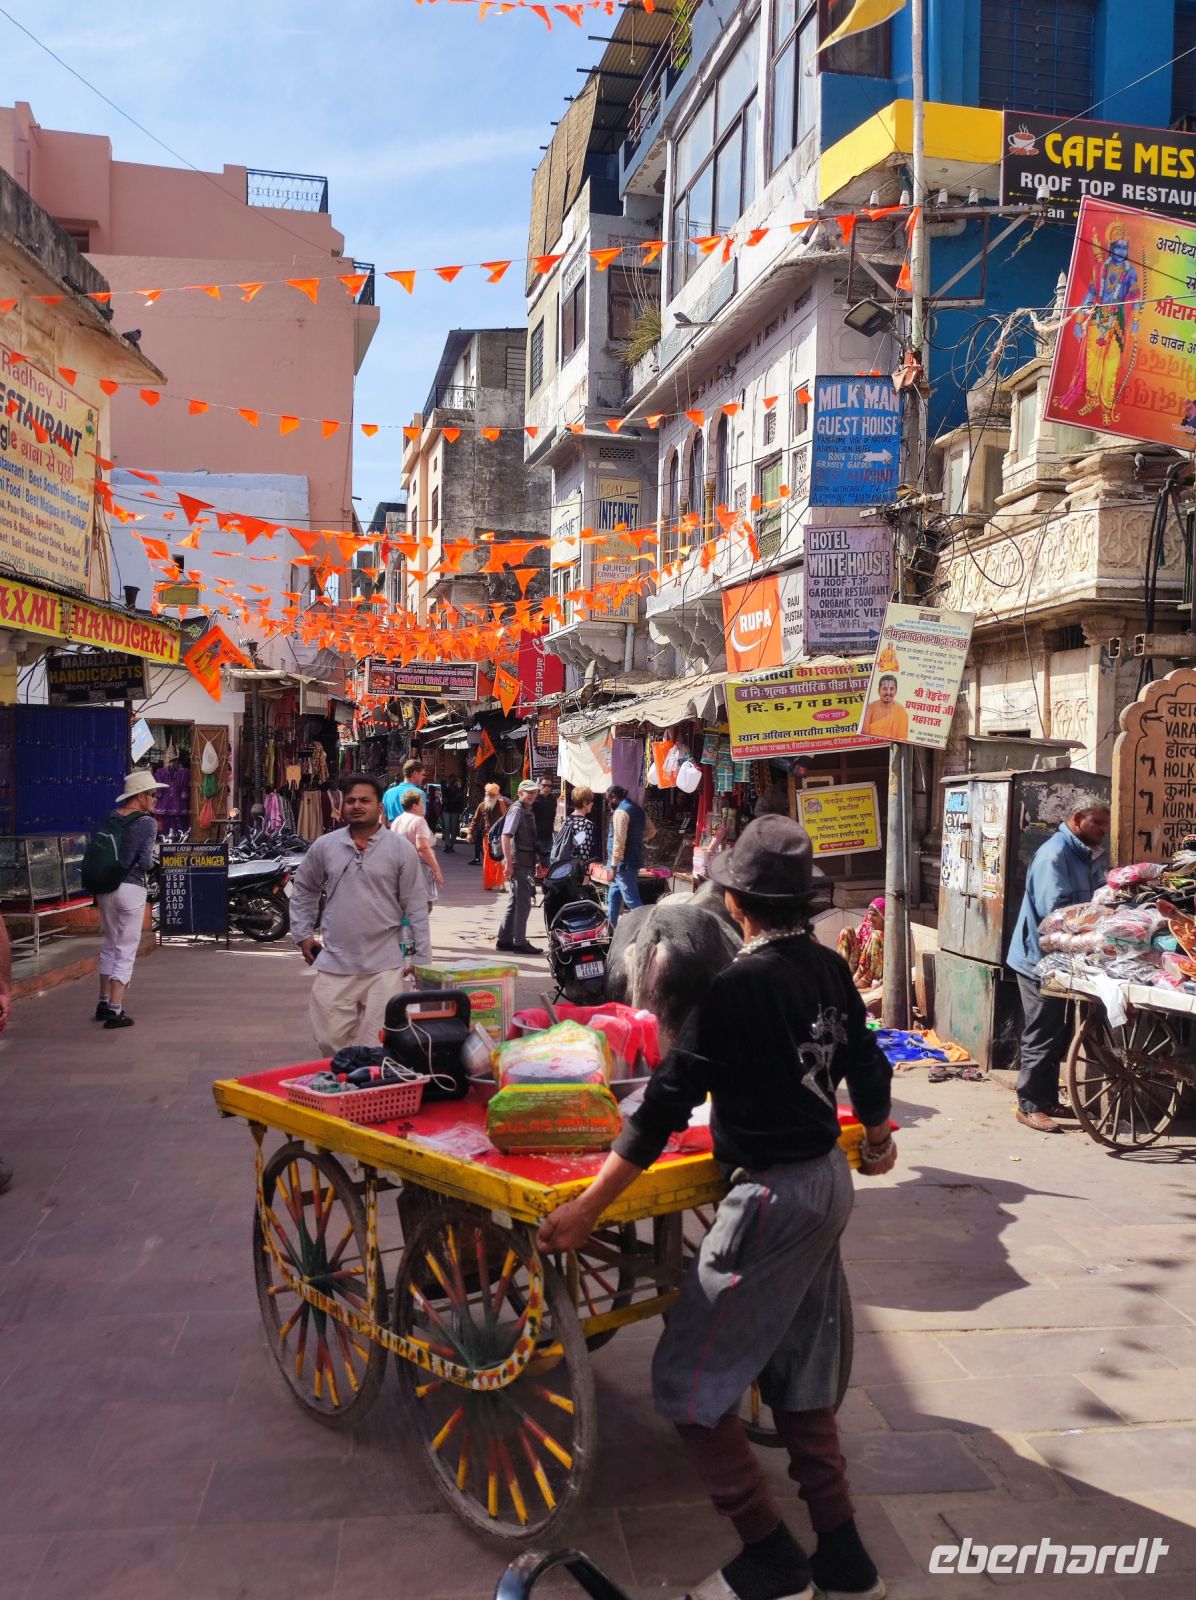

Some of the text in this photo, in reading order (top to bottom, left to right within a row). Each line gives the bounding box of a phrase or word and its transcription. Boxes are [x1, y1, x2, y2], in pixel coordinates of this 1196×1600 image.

[1044, 132, 1195, 179] CAFÉ MES
[1020, 172, 1072, 192] ROOF
[1078, 178, 1116, 196] TOP
[2, 350, 68, 412] Radhey Ji
[818, 384, 900, 413] MILK MAN
[816, 415, 898, 436] GUEST HOUSE
[828, 452, 864, 461] ROOF TOP
[28, 469, 43, 490] Best
[43, 476, 60, 498] South
[60, 486, 77, 508] Indian
[77, 493, 90, 513] Food
[6, 477, 21, 499] Food
[25, 487, 41, 507] Best
[61, 506, 67, 520] in
[67, 509, 87, 531] Pushkar
[809, 530, 850, 551] HOTEL
[807, 551, 891, 578] WHITE HOUSE
[808, 585, 890, 598] GARDEN RESTAURANT
[787, 595, 800, 608] RAJU
[820, 598, 874, 609] ORGANIC FOOD
[740, 608, 773, 633] RUPA
[810, 607, 885, 619] PANORAMIC VIEW
[73, 605, 178, 660] HANDICRAFT
[50, 665, 142, 684] HANDICRAFTS
[535, 657, 545, 679] airtel
[64, 680, 128, 691] Money Changer
[788, 680, 827, 694] शारीरिक
[914, 687, 925, 698] श्री
[822, 698, 832, 707] 8
[912, 715, 942, 727] महाराज
[1165, 721, 1196, 739] VARA
[762, 730, 791, 740] अखिल
[793, 726, 824, 738] भारतीय
[1164, 762, 1195, 778] HOLK
[162, 855, 225, 867] MONEY CHANGER
